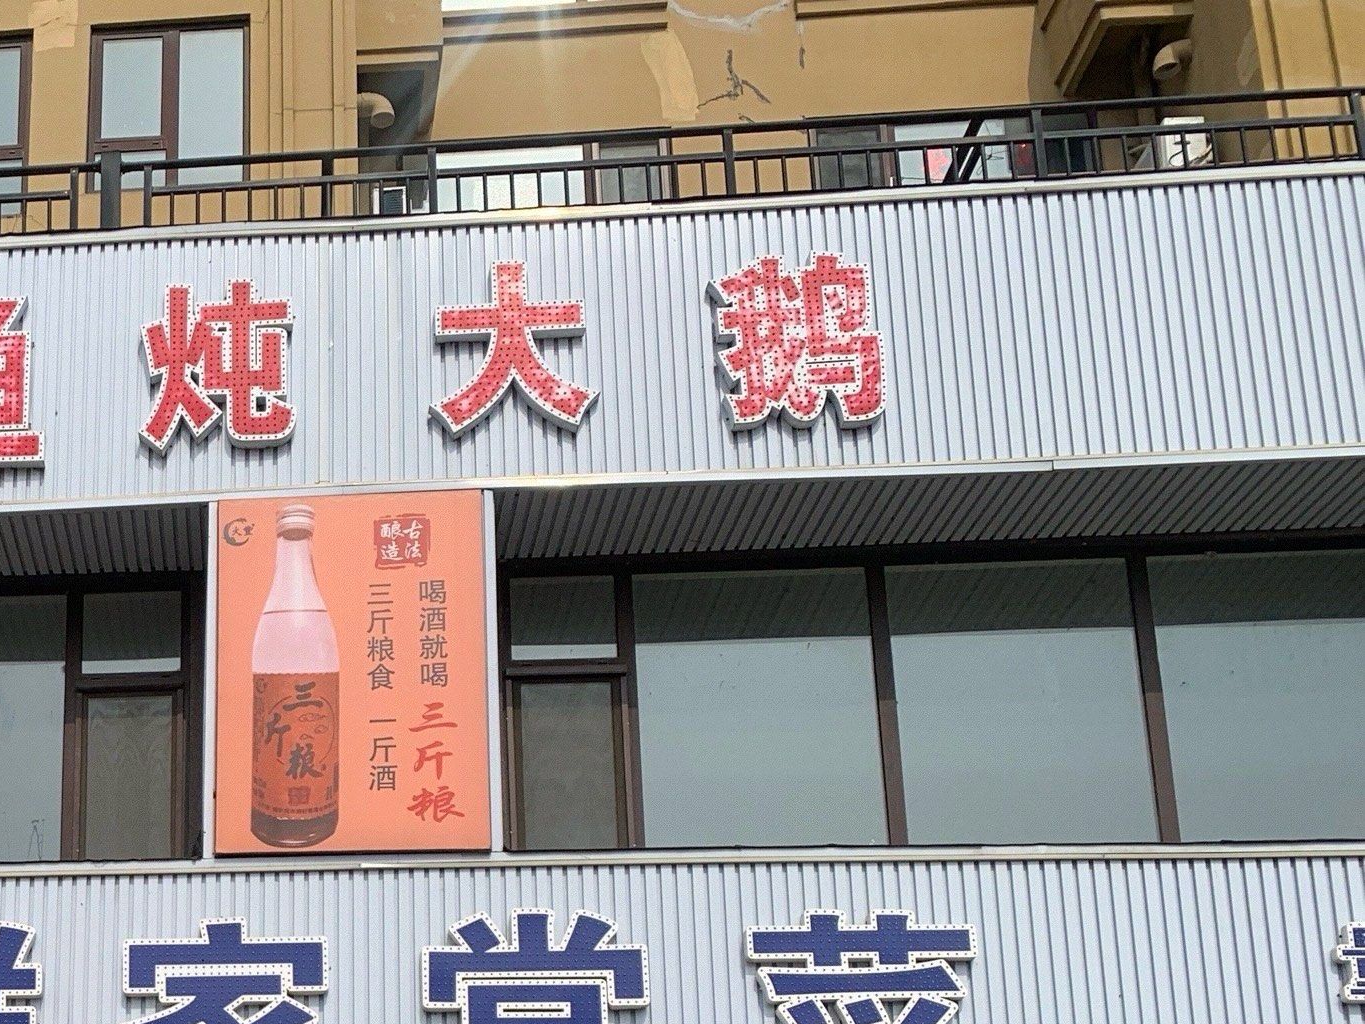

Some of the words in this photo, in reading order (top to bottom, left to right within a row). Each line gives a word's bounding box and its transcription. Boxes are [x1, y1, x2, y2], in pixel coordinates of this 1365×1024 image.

[366, 582, 395, 691] 三斤粮食
[418, 579, 449, 688] 喝酒就喝
[368, 717, 398, 792] 一斤酒
[407, 702, 466, 823] 三斤粮
